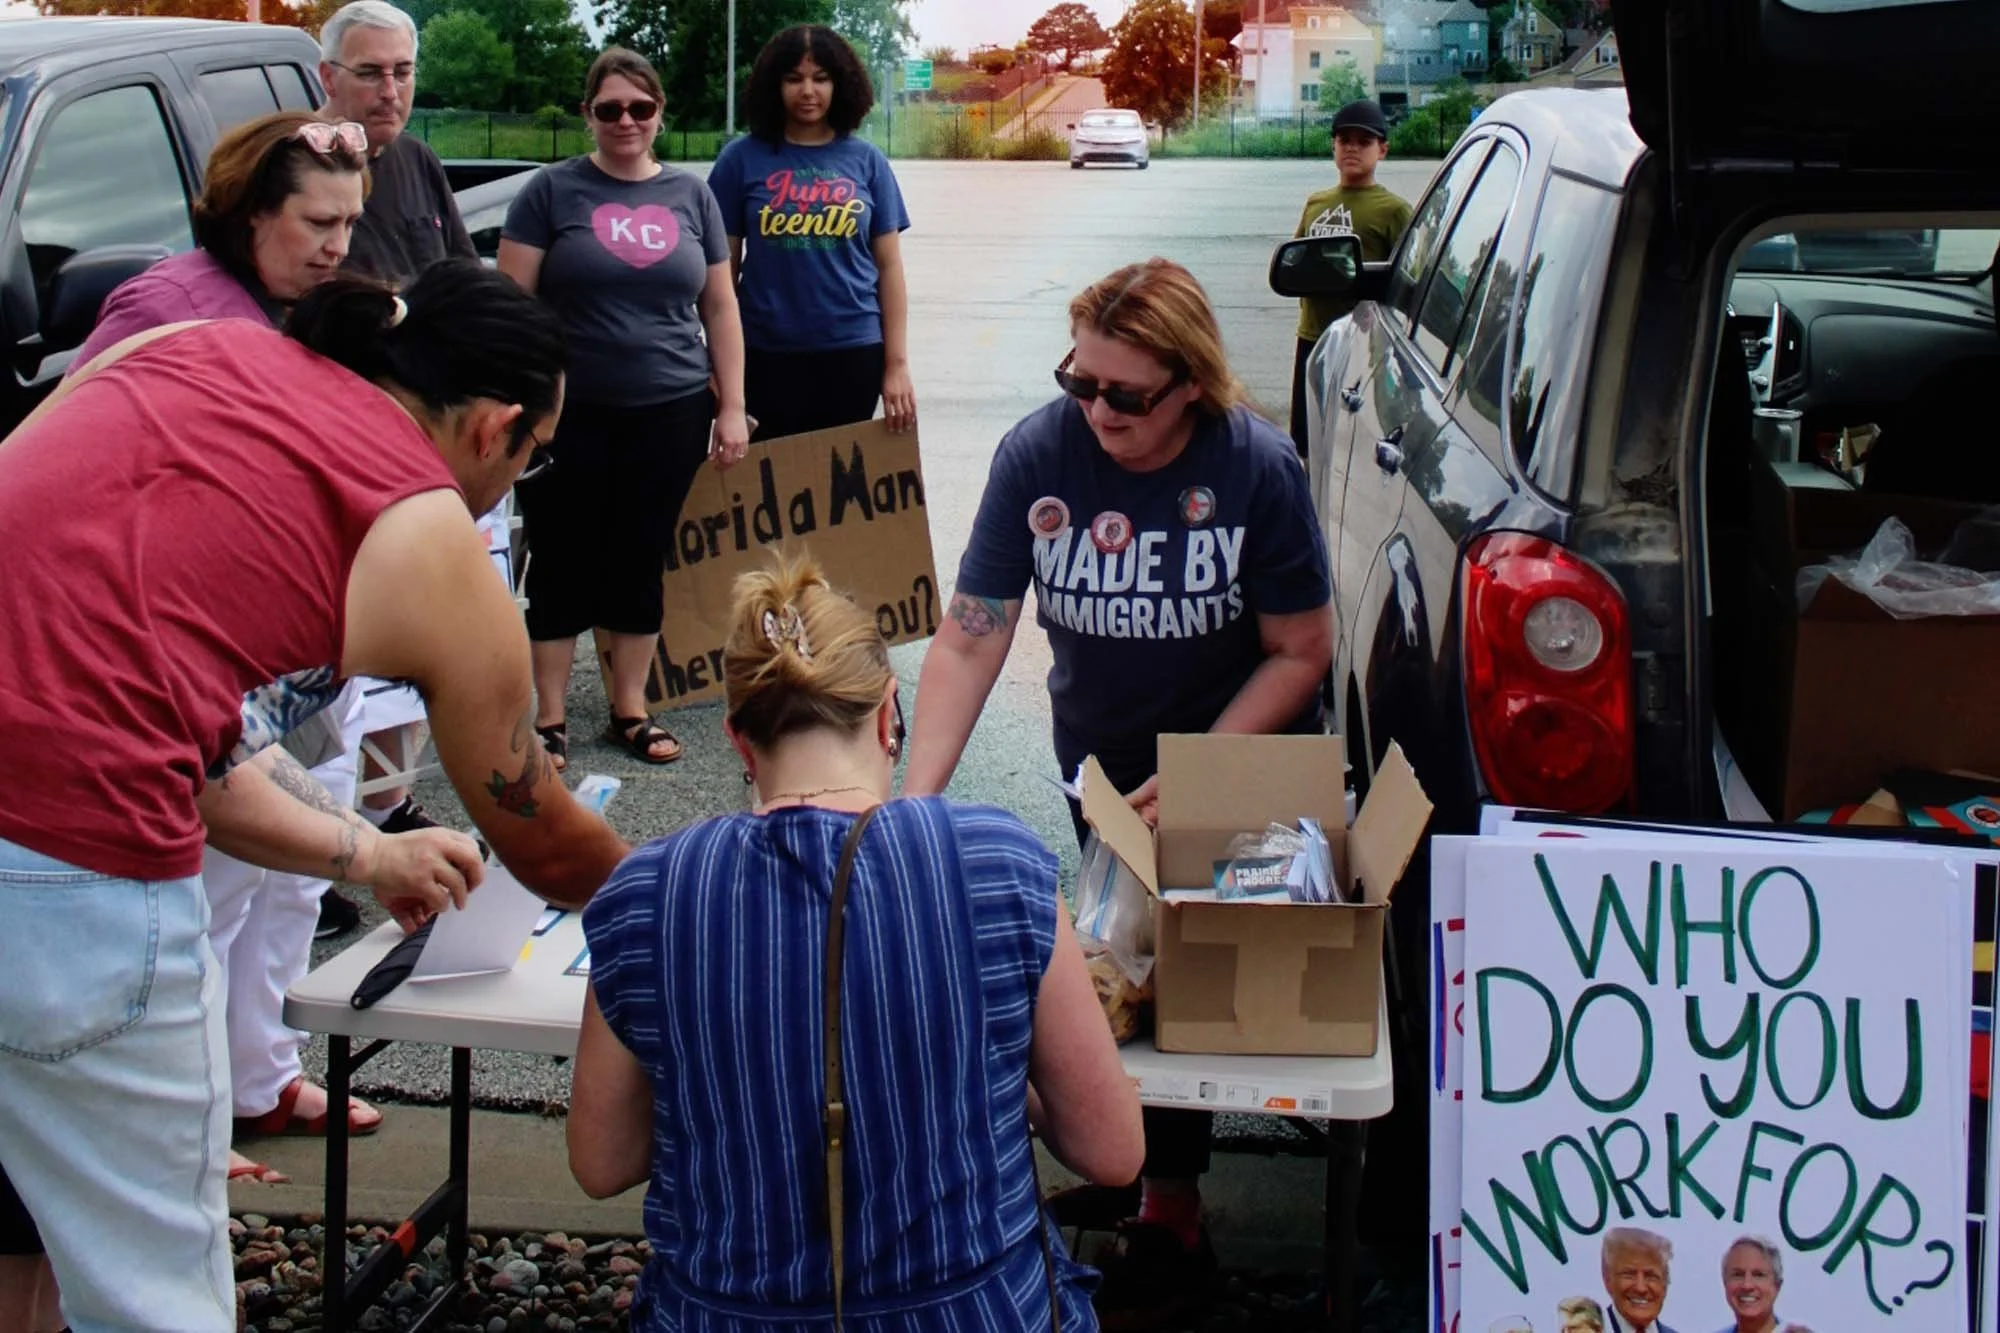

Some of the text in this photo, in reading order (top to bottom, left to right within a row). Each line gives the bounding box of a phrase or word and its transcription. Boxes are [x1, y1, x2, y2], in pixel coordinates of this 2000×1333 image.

[758, 199, 865, 240] teenth
[766, 168, 856, 210] June
[610, 217, 666, 250] KC
[666, 458, 816, 571] orida
[829, 441, 925, 526] Man
[1032, 526, 1168, 593] MADE
[1184, 526, 1246, 593] BY
[876, 575, 936, 640] ou?
[1534, 853, 1820, 989] WHO
[1476, 967, 1653, 1113] DO
[1461, 1112, 1726, 1294] WORK
[1733, 1120, 1955, 1315] FOR?
